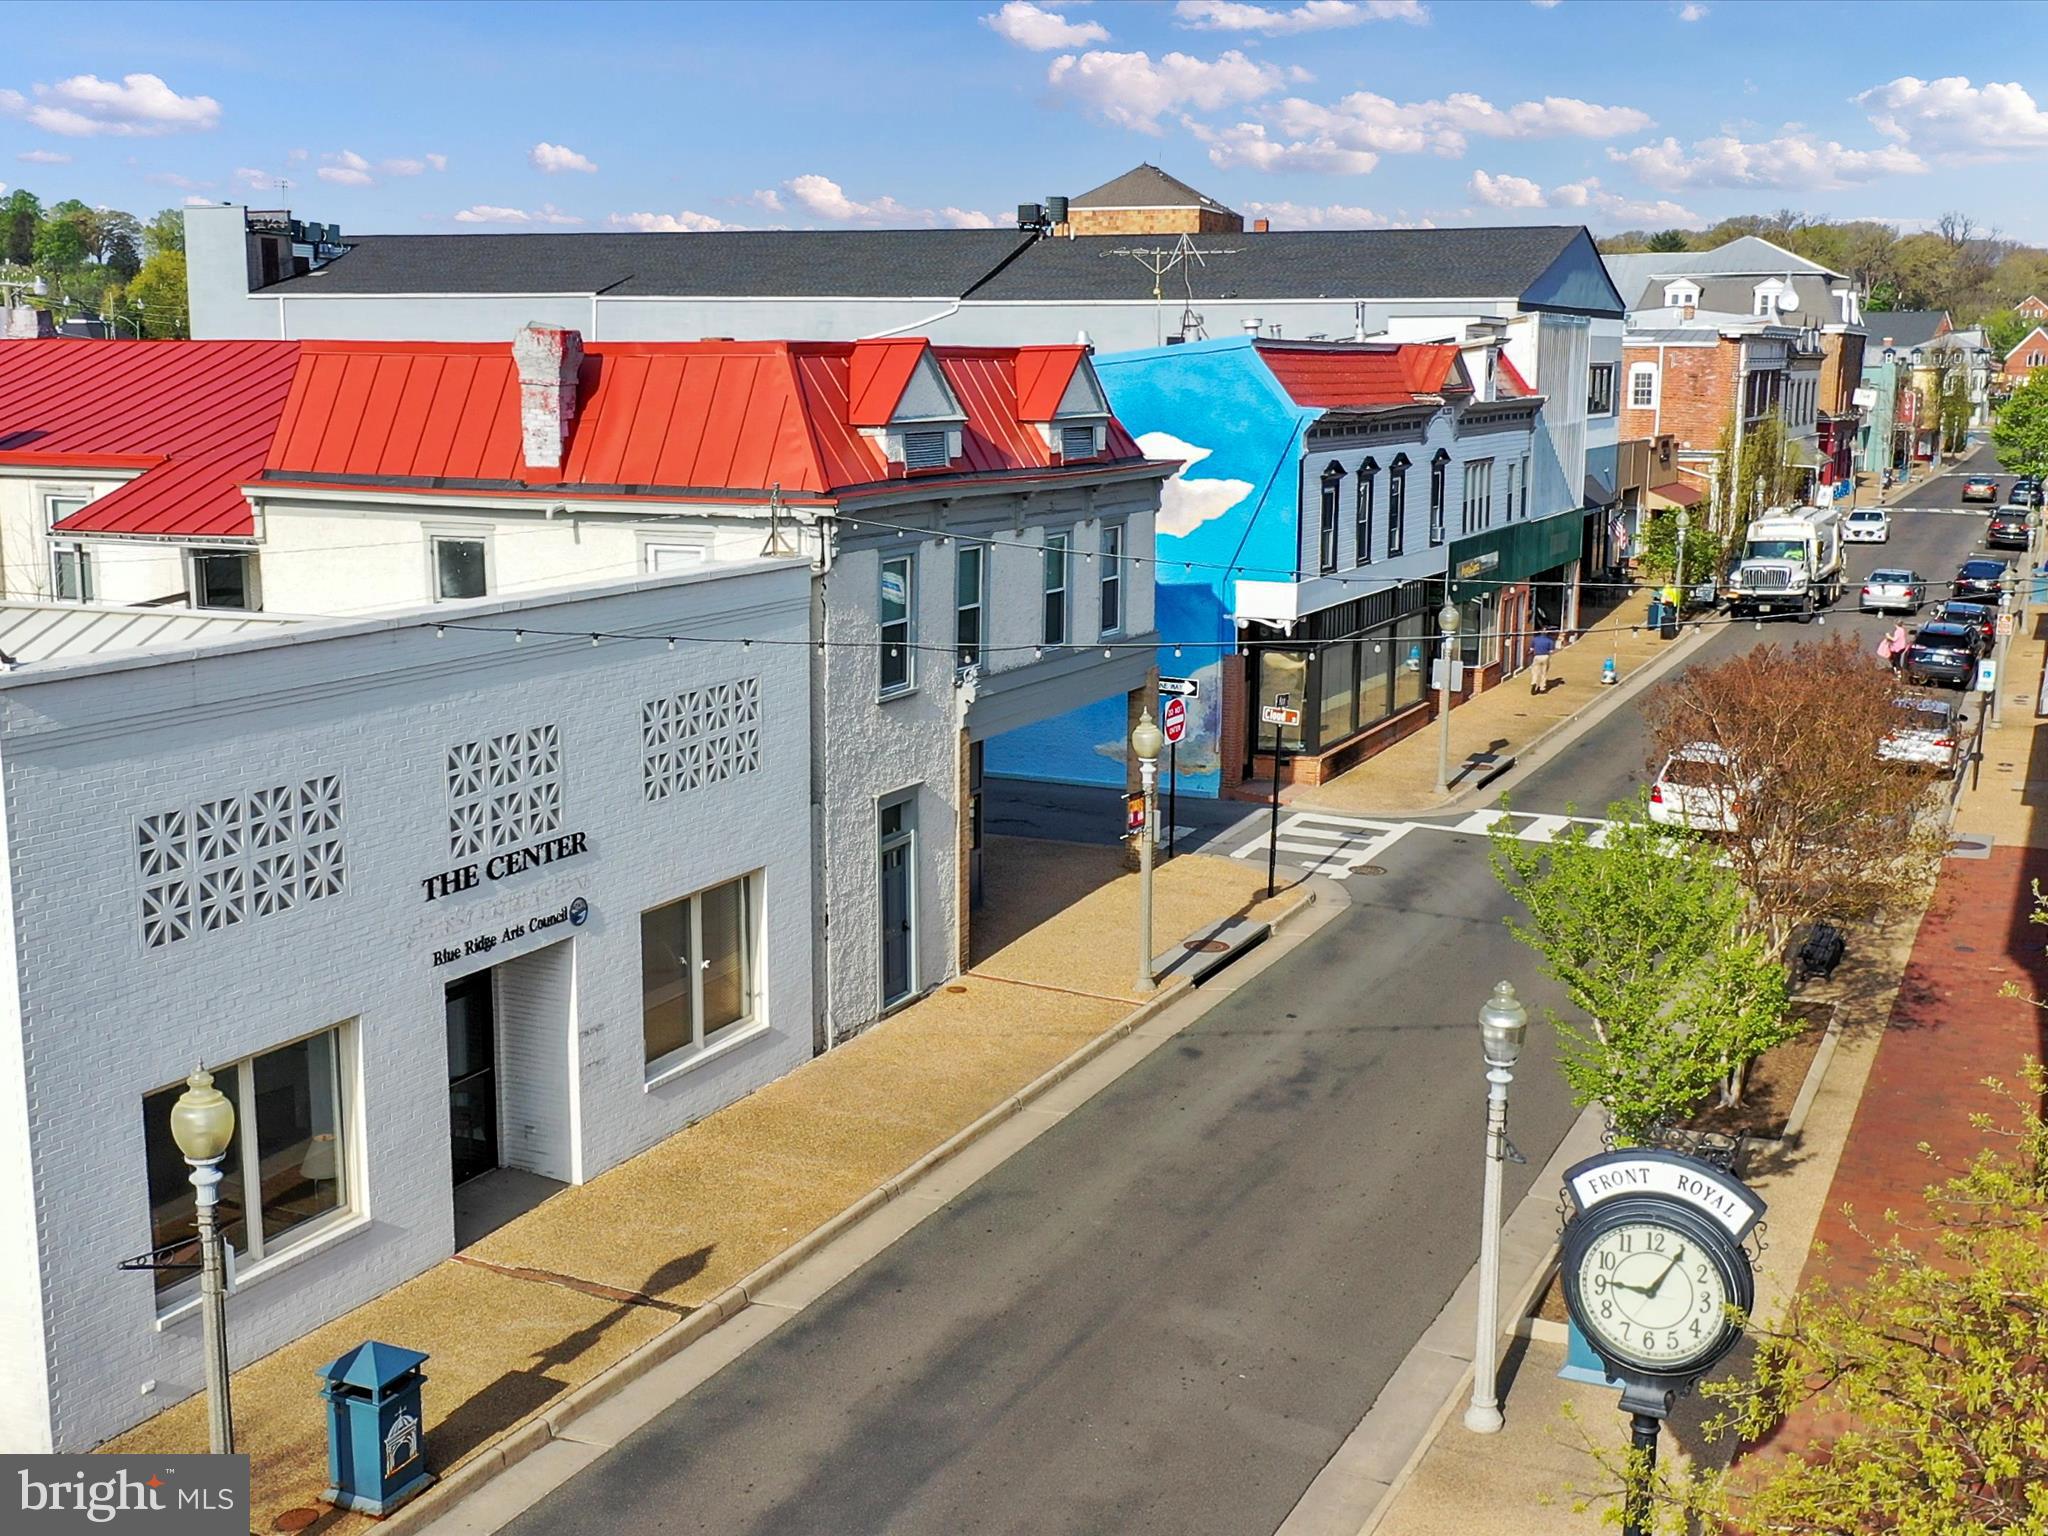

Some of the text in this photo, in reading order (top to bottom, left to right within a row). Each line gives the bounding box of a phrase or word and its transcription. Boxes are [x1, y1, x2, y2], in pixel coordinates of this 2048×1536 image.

[1174, 705, 1183, 715] NOT
[1168, 724, 1181, 735] ENTER
[421, 863, 480, 902] THE
[486, 831, 588, 881] CENTER
[432, 906, 568, 967] Blue Ridge Arts Council
[1588, 1167, 1734, 1218] FRONT ROYAL
[1619, 1232, 1633, 1253] 11
[1647, 1231, 1666, 1253] 12
[1599, 1250, 1616, 1271] 10
[1696, 1264, 1708, 1284] 2
[1594, 1274, 1607, 1296] 9
[1600, 1299, 1613, 1319] 8
[1699, 1291, 1711, 1314] 3
[1620, 1321, 1632, 1342] 7
[1689, 1318, 1702, 1339] 4
[1642, 1331, 1655, 1350] 6
[1666, 1331, 1680, 1350] 5
